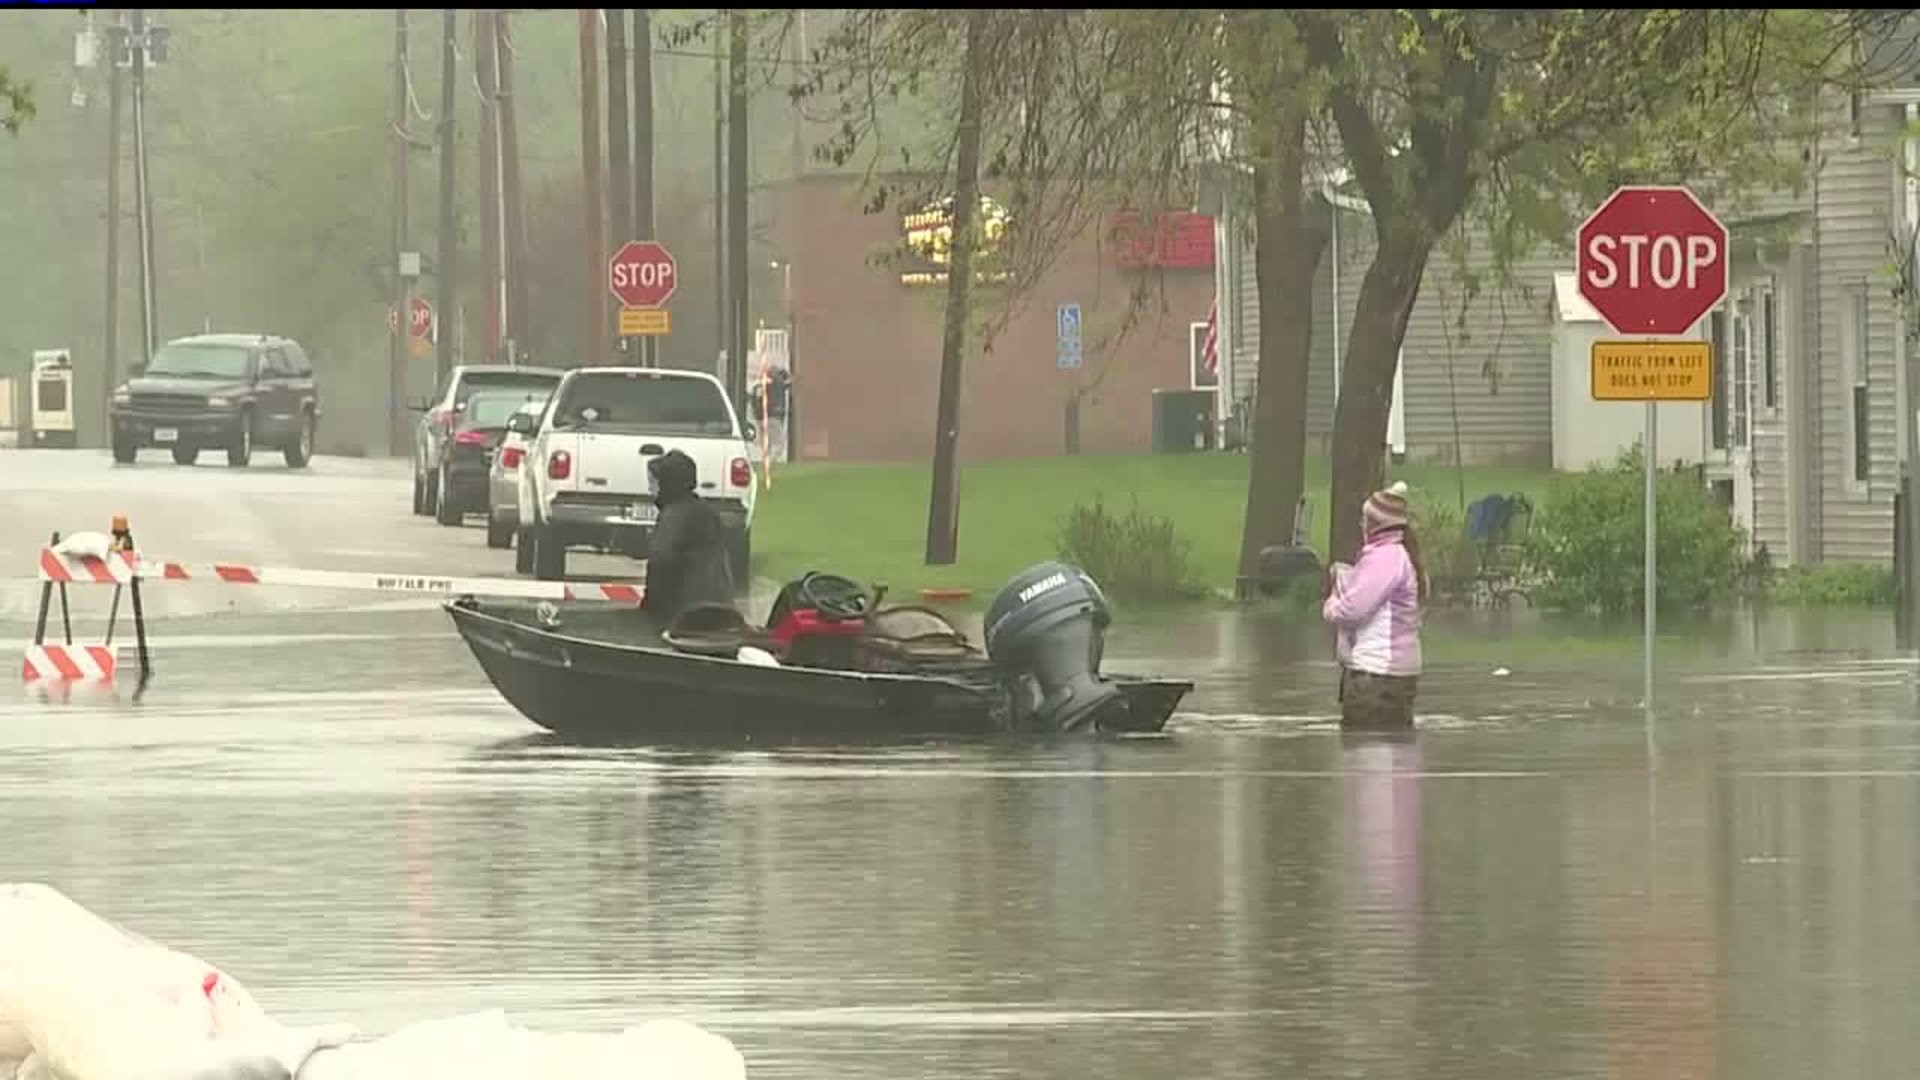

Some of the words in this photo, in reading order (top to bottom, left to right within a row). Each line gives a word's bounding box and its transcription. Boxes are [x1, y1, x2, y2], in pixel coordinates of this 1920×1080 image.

[1586, 234, 1717, 289] STOP
[613, 262, 672, 287] STOP
[1601, 355, 1643, 368] TRAFFIC
[1647, 355, 1675, 368] FROM
[1679, 355, 1703, 368] LEFT
[1610, 374, 1637, 386] DOES
[1642, 374, 1661, 386] NOT
[1667, 374, 1692, 386] STOP
[1018, 572, 1067, 603] YAMAHA
